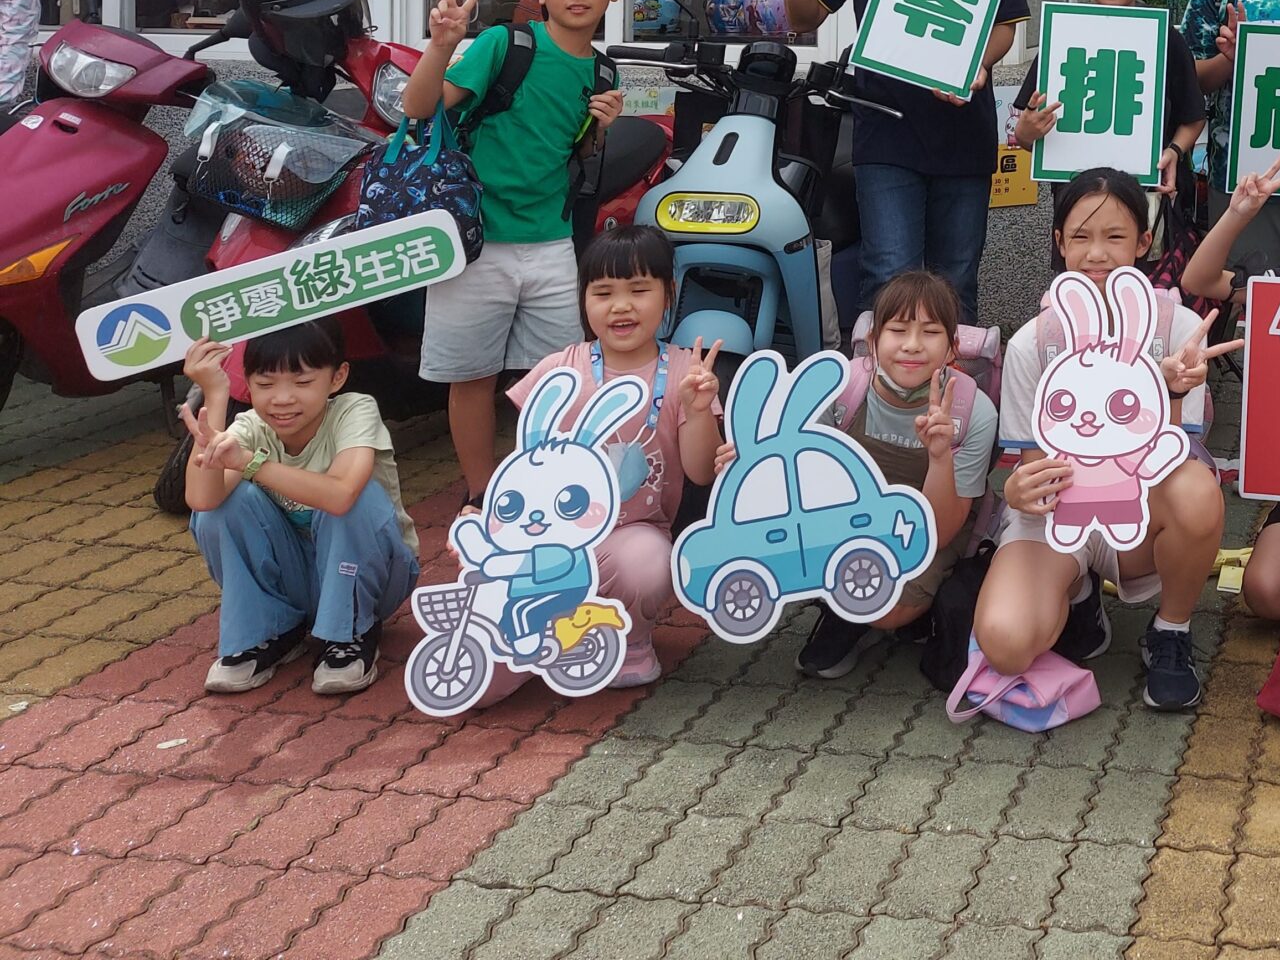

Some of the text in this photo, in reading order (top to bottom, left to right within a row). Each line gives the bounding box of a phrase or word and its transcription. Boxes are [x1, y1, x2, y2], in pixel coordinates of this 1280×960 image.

[1056, 46, 1146, 137] 排
[193, 235, 441, 338] 淨零綠生活
